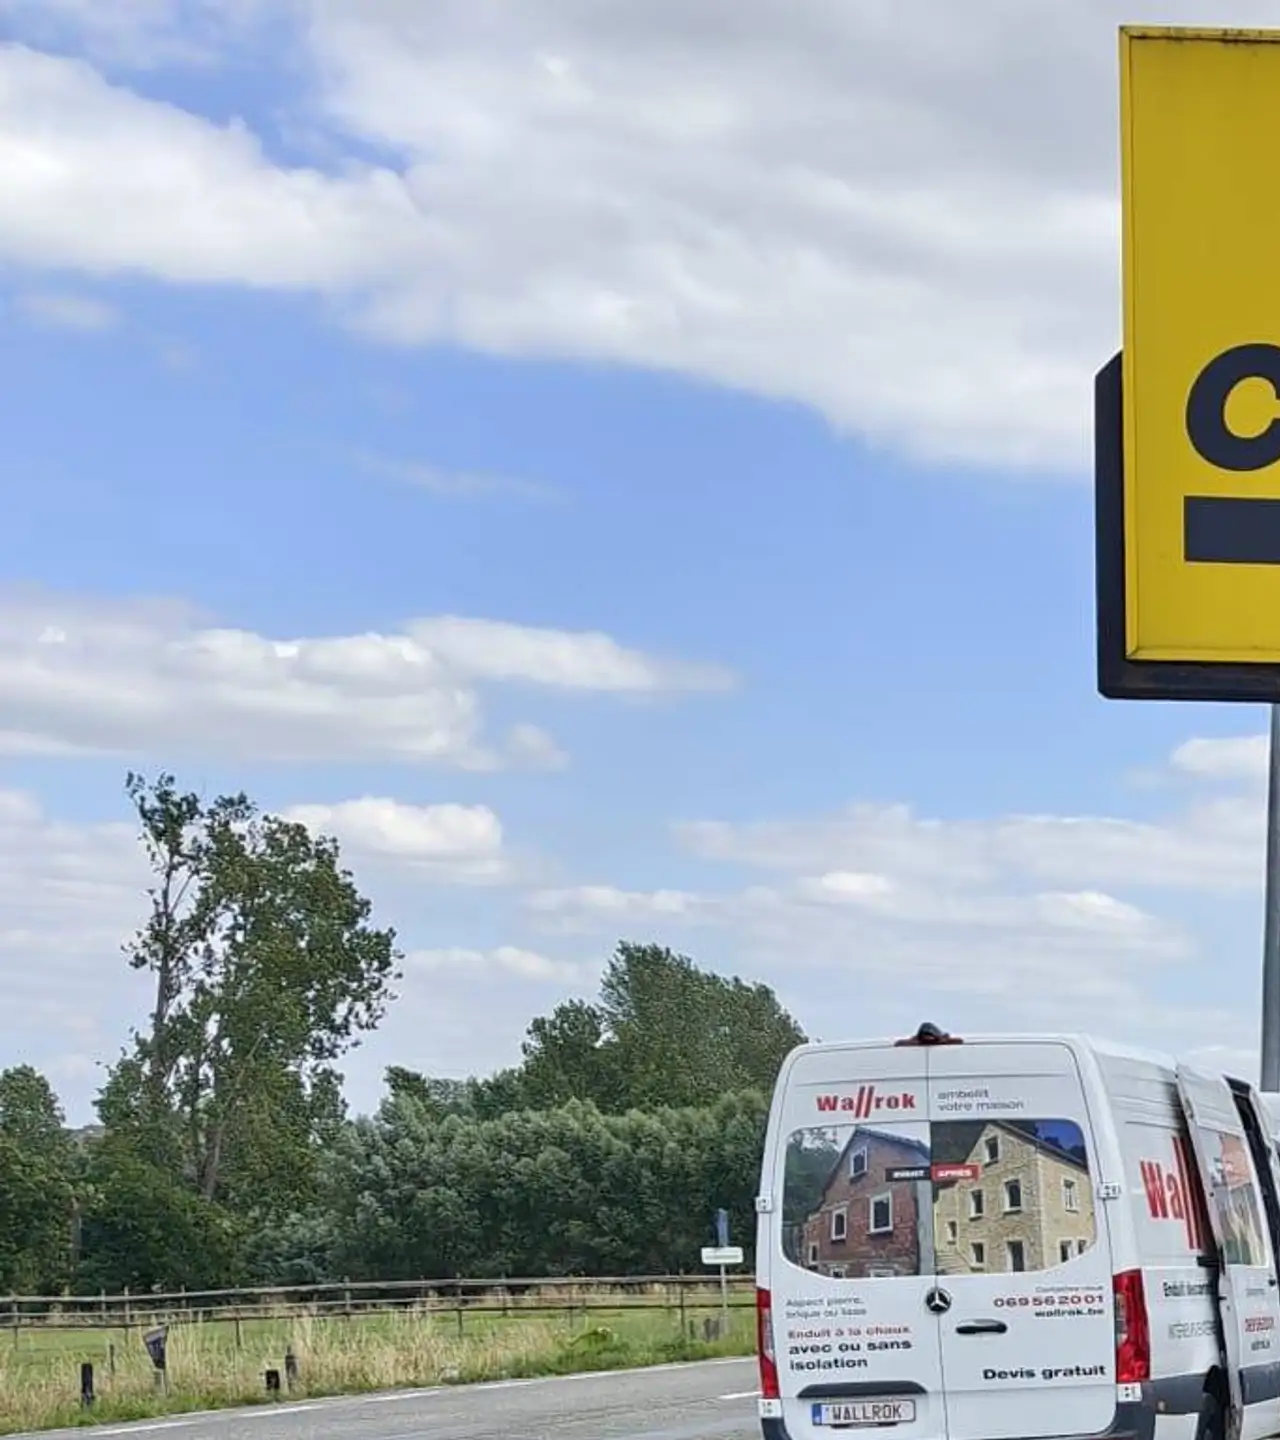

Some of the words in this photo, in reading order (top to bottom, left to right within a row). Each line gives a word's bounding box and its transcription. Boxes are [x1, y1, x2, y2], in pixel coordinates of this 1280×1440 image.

[788, 1327, 832, 1339] Enduit
[849, 1326, 863, 1337] la
[866, 1325, 912, 1336] chaux
[789, 1343, 832, 1356] avec
[838, 1341, 861, 1353] ou
[867, 1339, 912, 1351] sans
[789, 1357, 869, 1372] isolation
[983, 1367, 1037, 1380] Devis
[1041, 1364, 1107, 1380] gratuit
[832, 1403, 903, 1422] WALLROK
